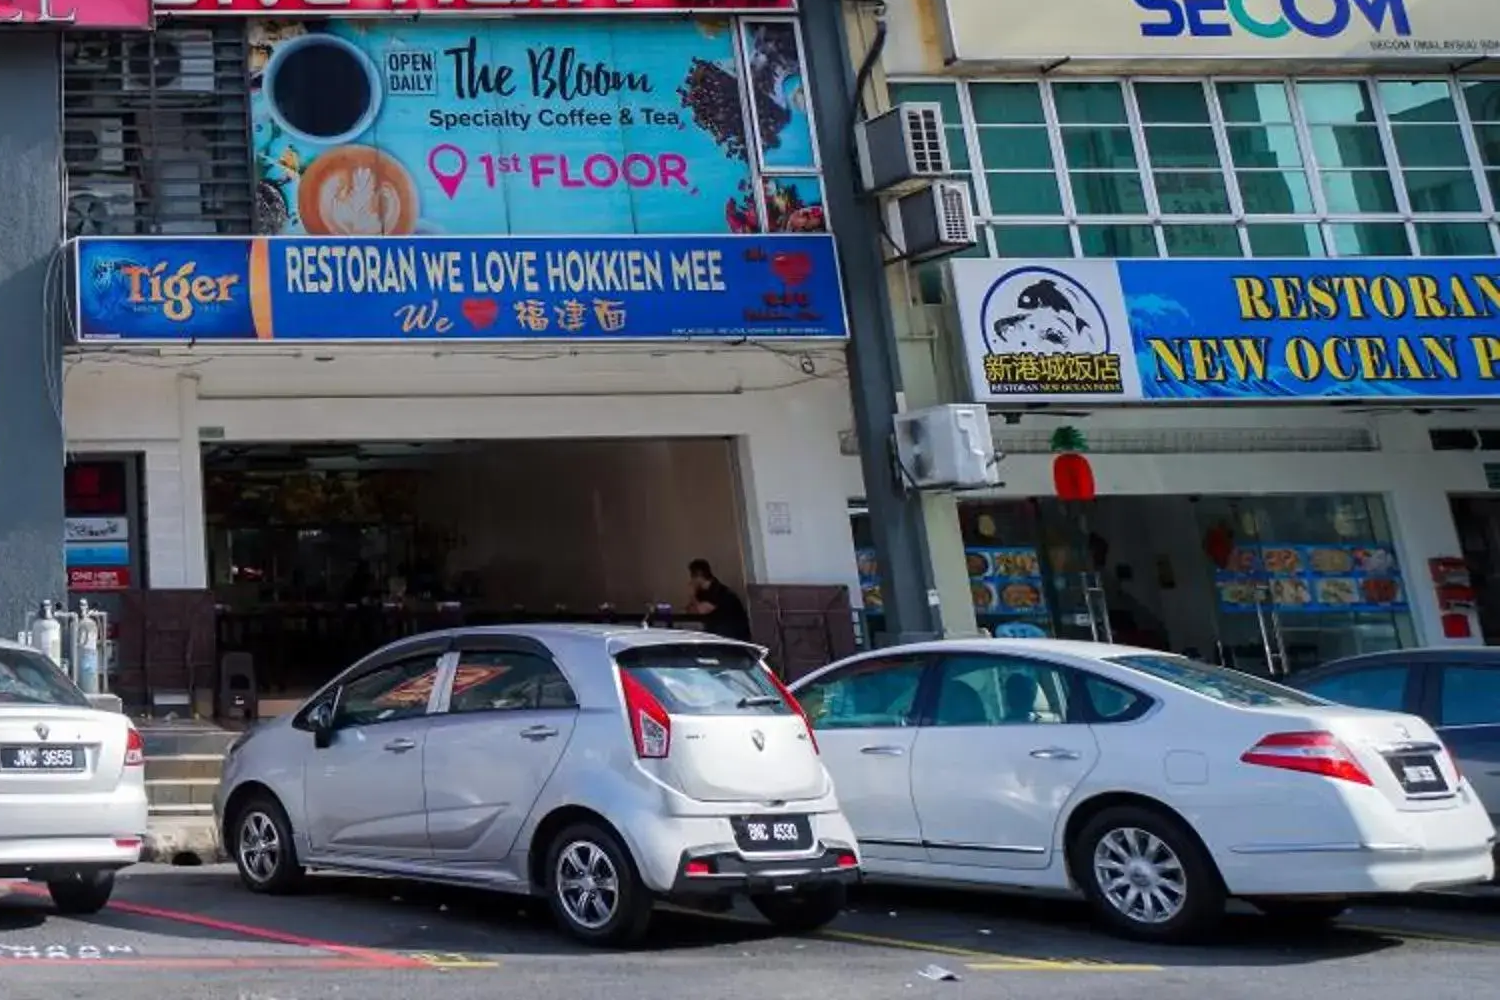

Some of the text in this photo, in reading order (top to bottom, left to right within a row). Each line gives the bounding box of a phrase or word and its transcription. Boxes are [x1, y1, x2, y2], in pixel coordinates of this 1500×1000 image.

[388, 53, 432, 72] OPEN
[390, 73, 433, 92] DAILY
[444, 37, 652, 101] The Bloom
[429, 108, 531, 131] Specialty
[538, 108, 612, 127] Coffee
[618, 108, 634, 126] &
[478, 153, 690, 189] 1st FLOOR
[286, 246, 726, 293] RESTORAN WE LOVE HOKKIEN MEE
[120, 261, 240, 321] Tiger
[1232, 275, 1500, 320] RESTORAN
[394, 301, 455, 333] We
[1148, 336, 1272, 382] NEW
[1285, 336, 1461, 382] OCEAN
